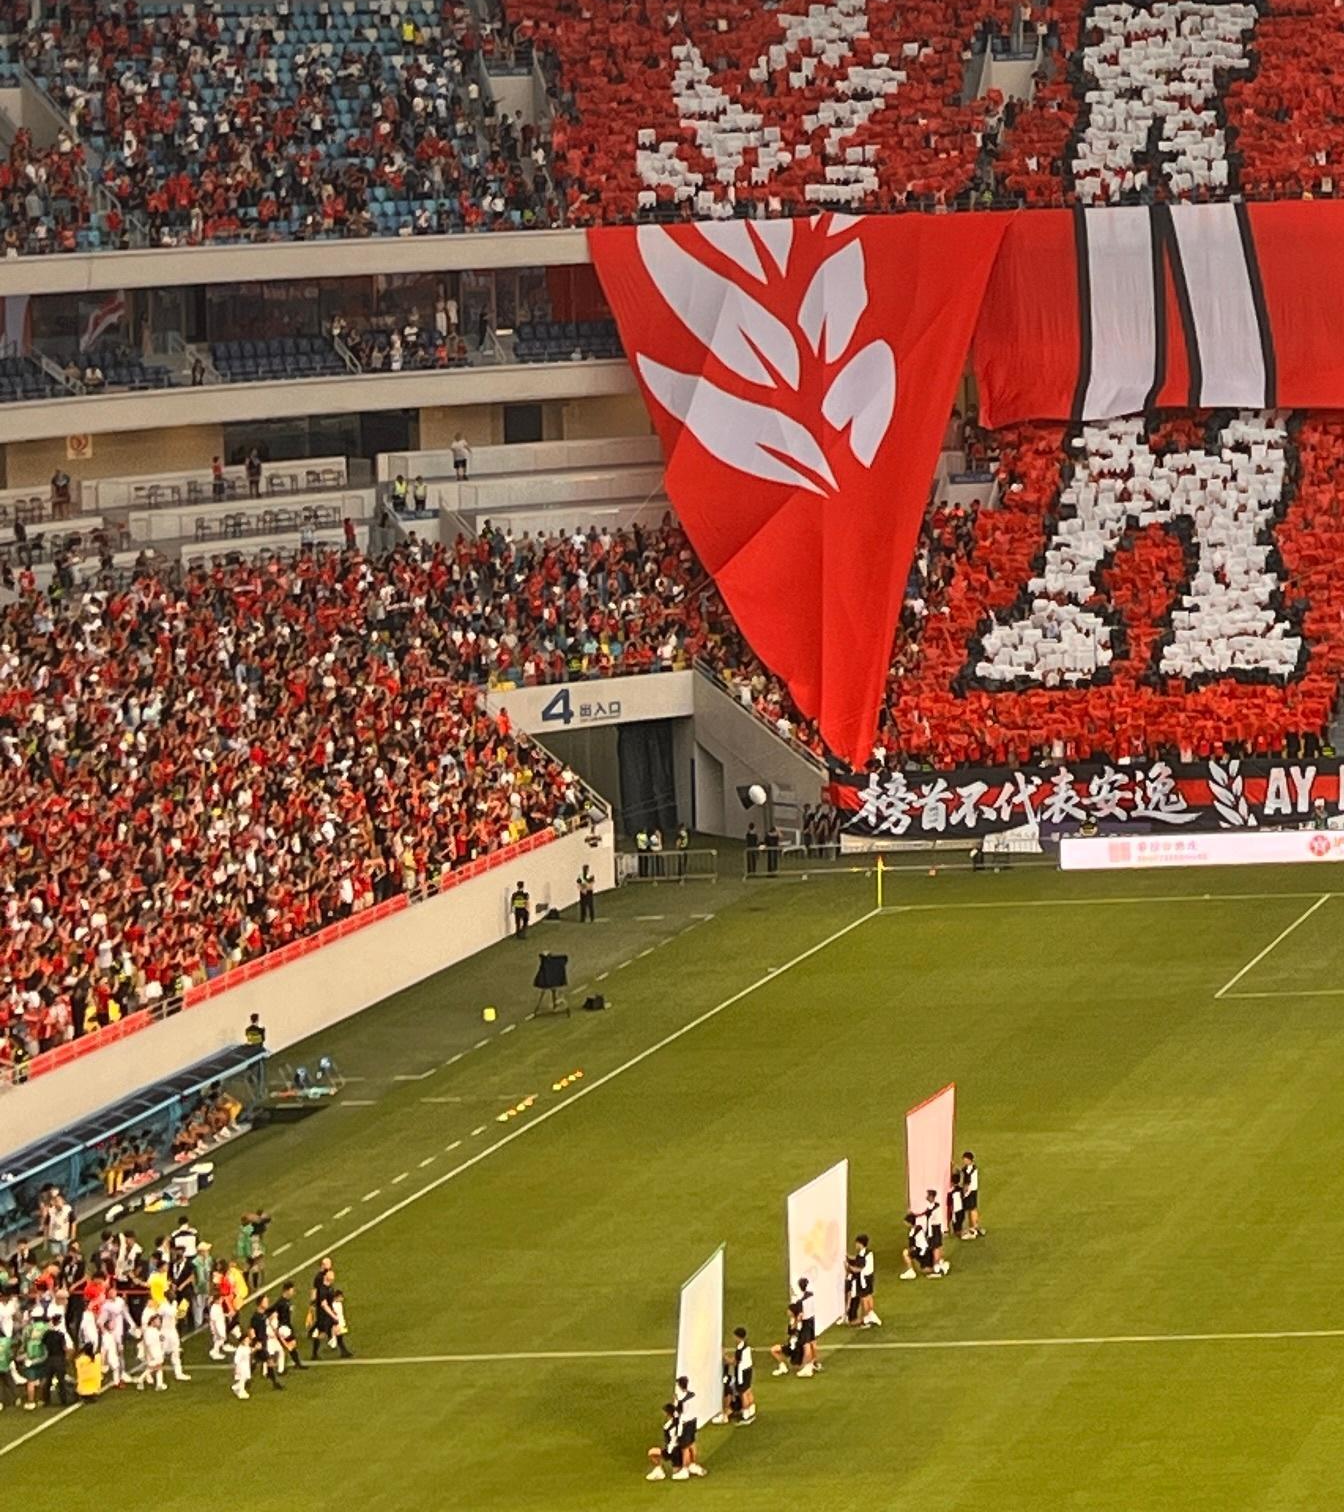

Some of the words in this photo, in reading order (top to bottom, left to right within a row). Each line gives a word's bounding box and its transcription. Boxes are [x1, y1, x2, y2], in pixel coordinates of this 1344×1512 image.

[541, 688, 574, 725] 4
[580, 701, 621, 717] 出入口
[841, 761, 1202, 835] 榜首不代表安逸
